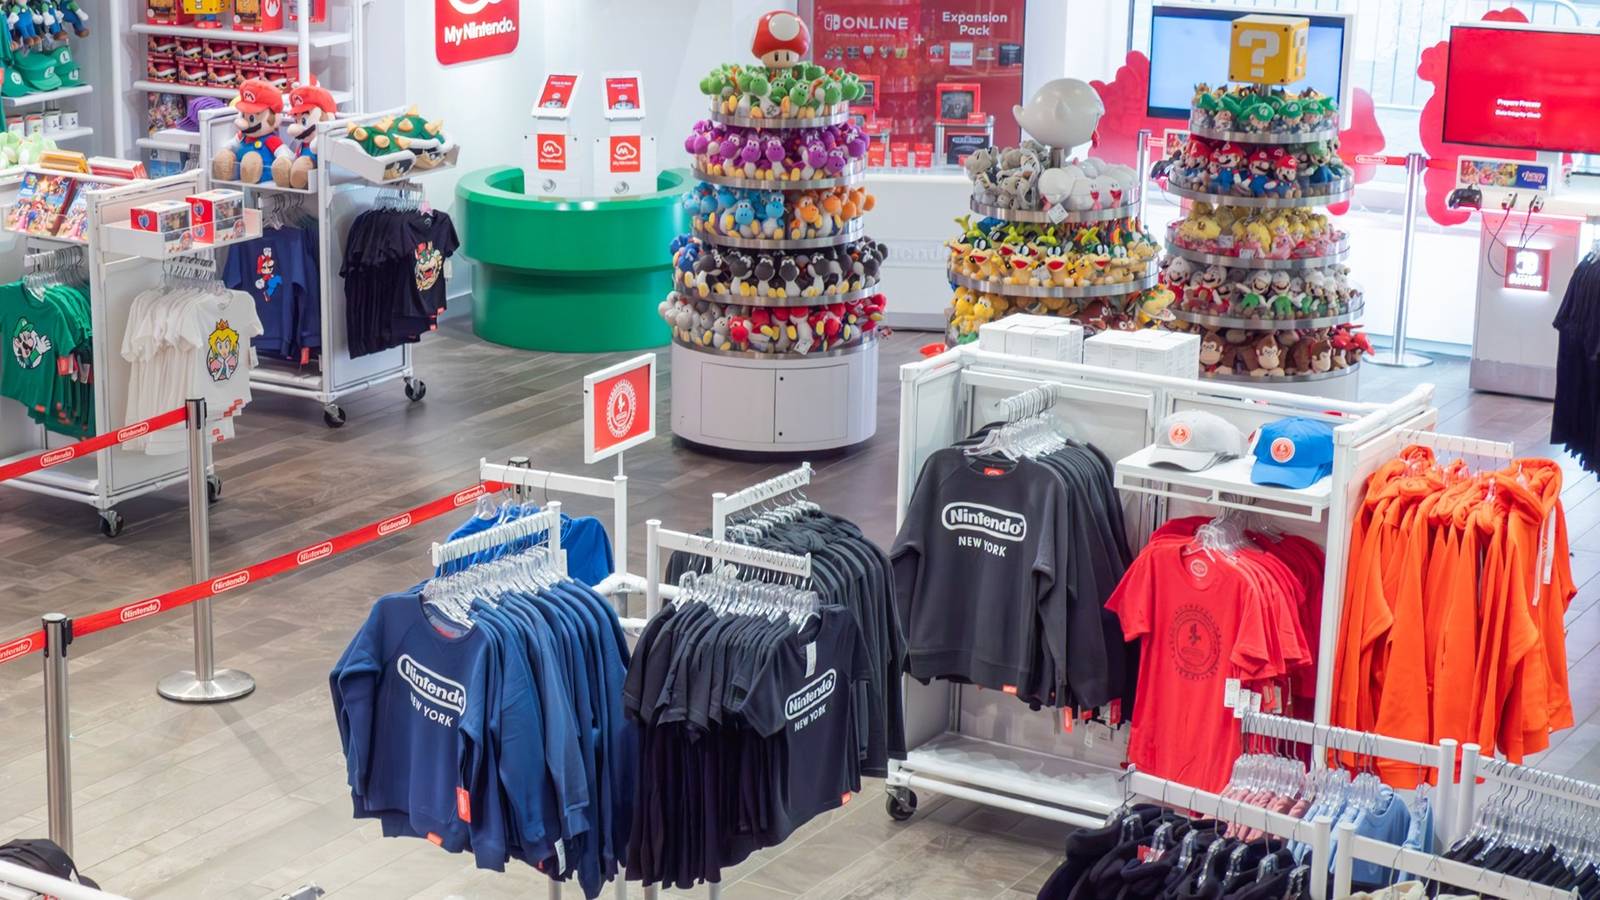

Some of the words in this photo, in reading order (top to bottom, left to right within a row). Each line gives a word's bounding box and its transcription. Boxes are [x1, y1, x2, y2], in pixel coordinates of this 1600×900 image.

[842, 15, 909, 29] ONLINE
[942, 11, 1008, 24] Expansion
[444, 25, 462, 46] My
[959, 24, 990, 36] Pack
[119, 424, 148, 440] Nintendo
[43, 450, 72, 464] Nintendo
[380, 517, 409, 532] Nintendo
[950, 508, 1021, 535] Nintendo
[300, 546, 331, 562] Nintendo
[958, 536, 982, 548] NEW
[983, 540, 1007, 557] YORK
[214, 574, 247, 590] Nintendo
[123, 603, 158, 619] Nintendo
[789, 677, 832, 714] Nintendo
[423, 705, 454, 727] YORK
[795, 716, 809, 732] NEW
[809, 703, 827, 722] YORK
